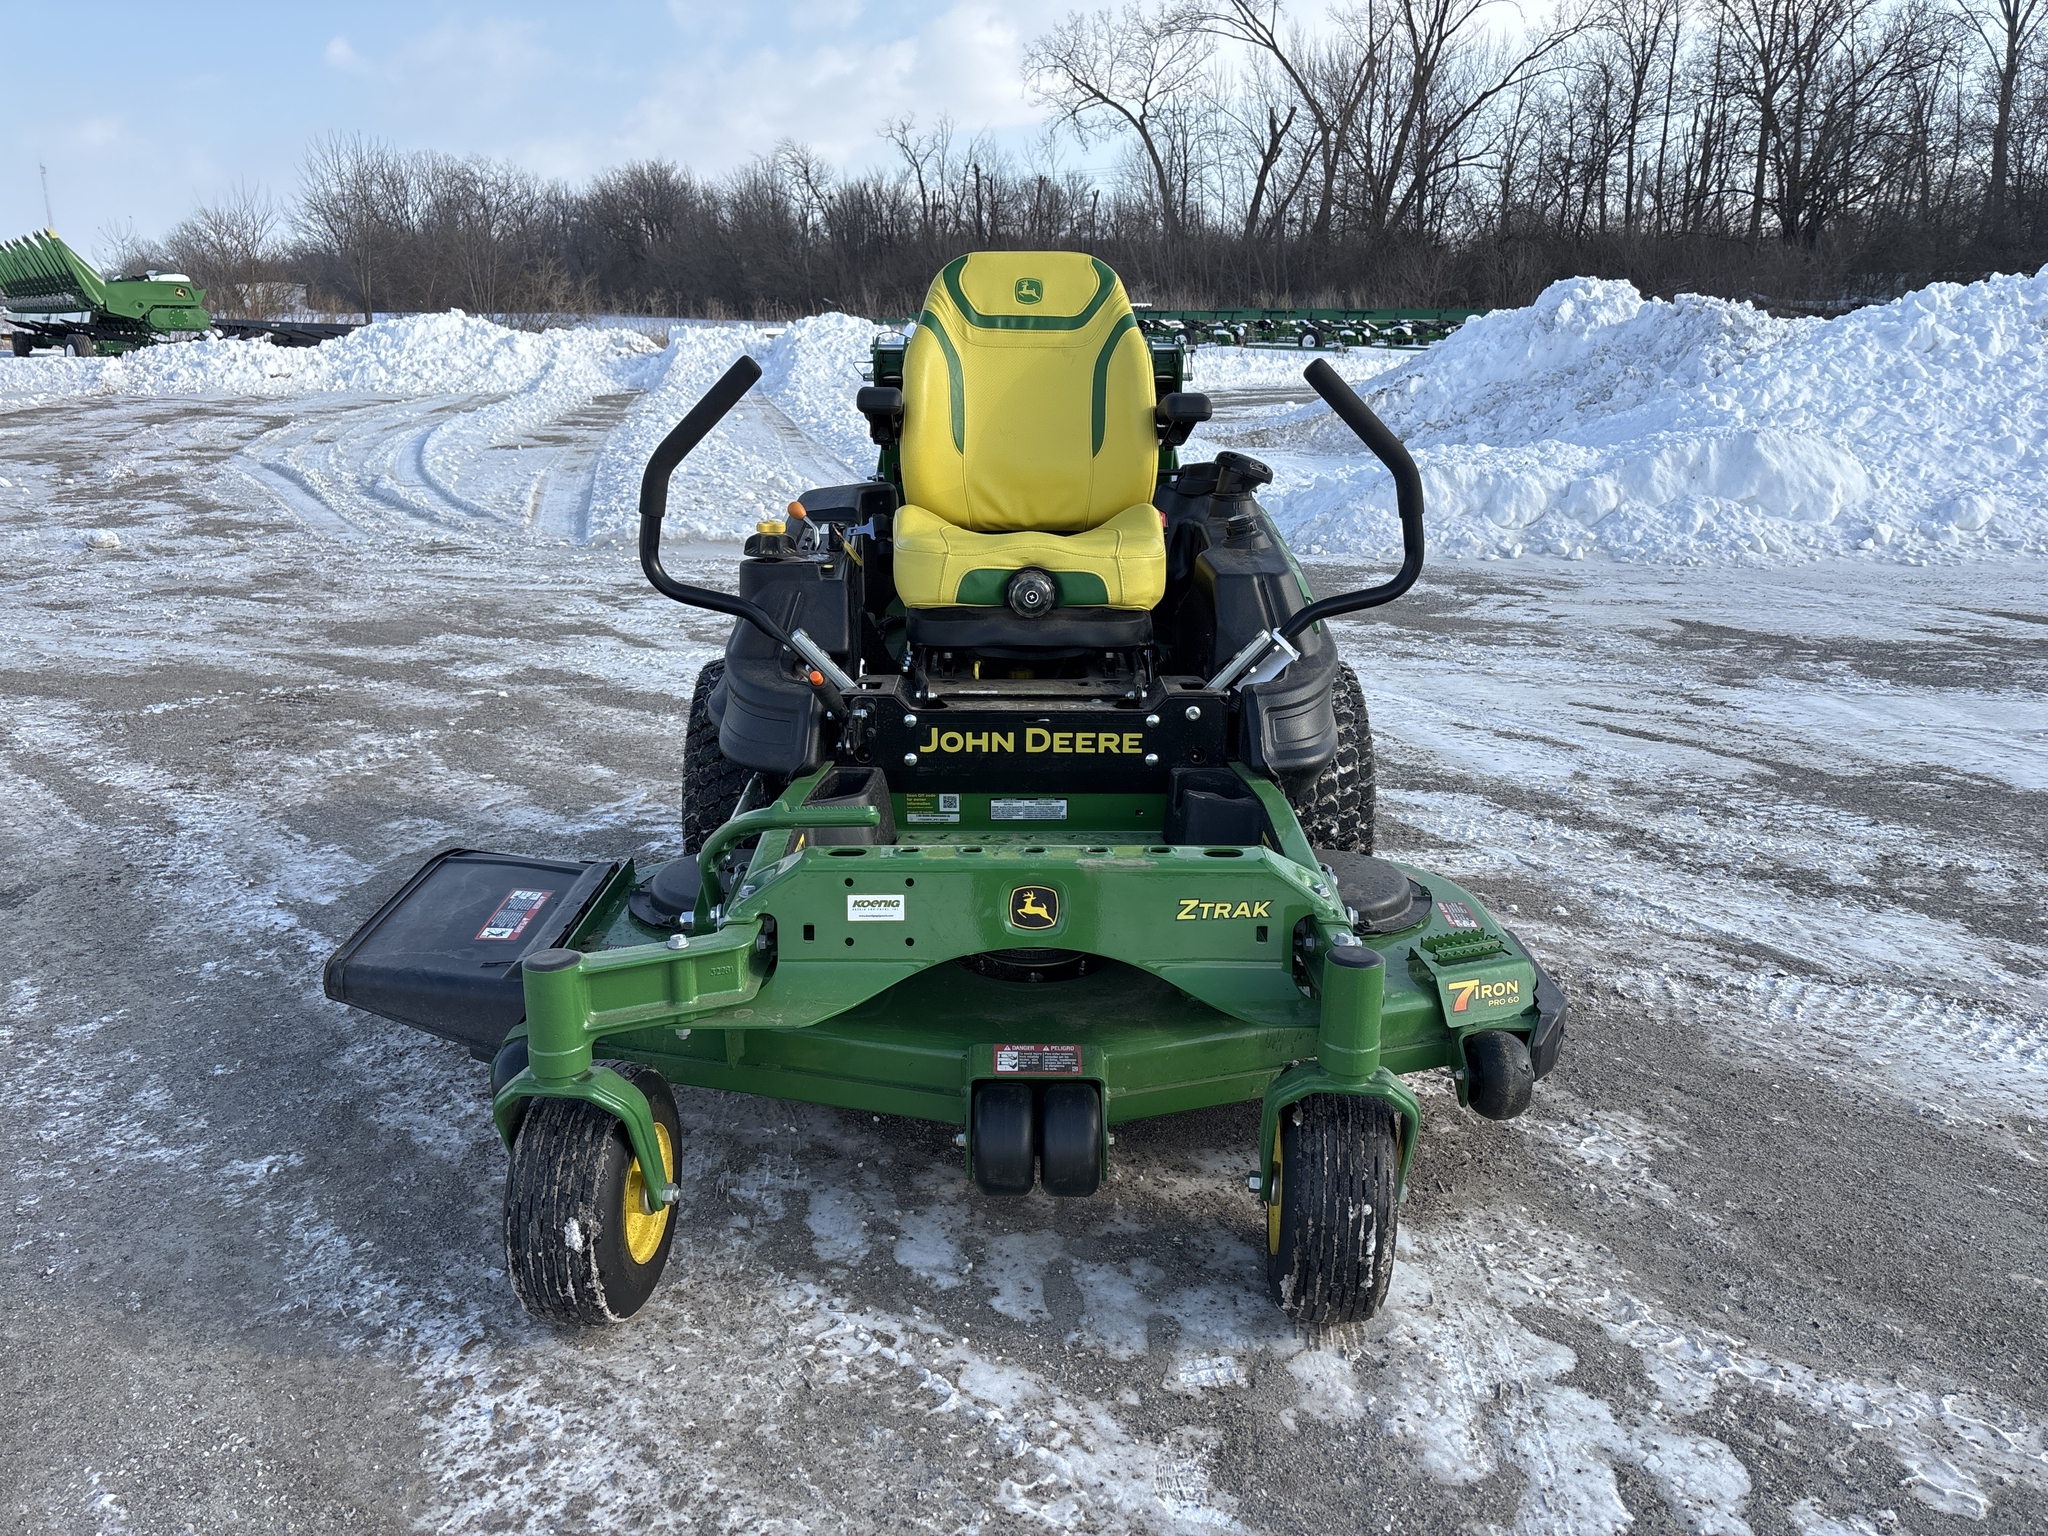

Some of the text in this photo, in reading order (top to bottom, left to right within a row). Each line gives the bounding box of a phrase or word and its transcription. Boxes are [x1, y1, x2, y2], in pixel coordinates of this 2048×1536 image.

[919, 727, 1144, 754] JOHN DEERE
[1175, 898, 1273, 920] ZTRAK
[1488, 996, 1520, 1007] PRO 60
